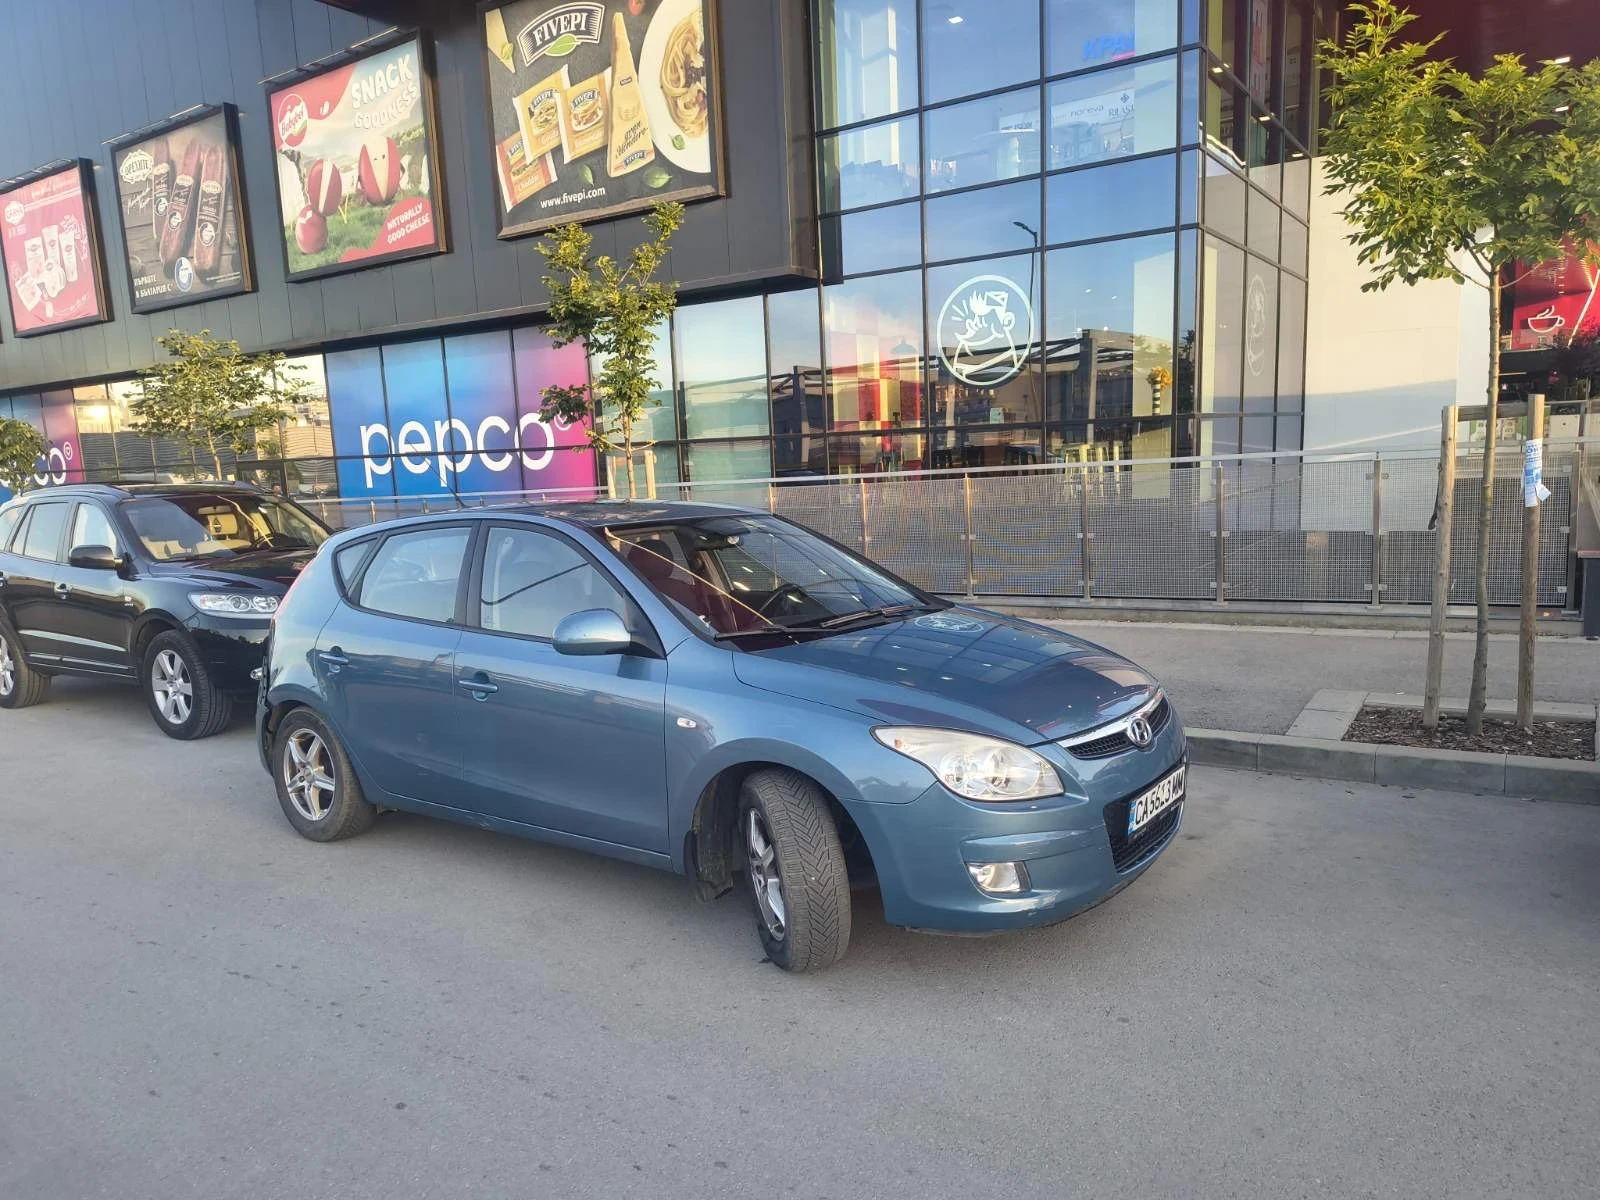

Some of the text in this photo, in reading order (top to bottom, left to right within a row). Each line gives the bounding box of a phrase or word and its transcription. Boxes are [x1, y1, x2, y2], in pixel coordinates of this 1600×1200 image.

[533, 11, 588, 47] FIVEPI
[352, 54, 413, 109] SNACK
[354, 82, 417, 130] GOODNESS
[540, 186, 606, 209] www.fivepi.com
[387, 202, 422, 231] NATURALLY
[387, 212, 430, 245] GOOD CHEESE
[360, 412, 555, 489] pepco
